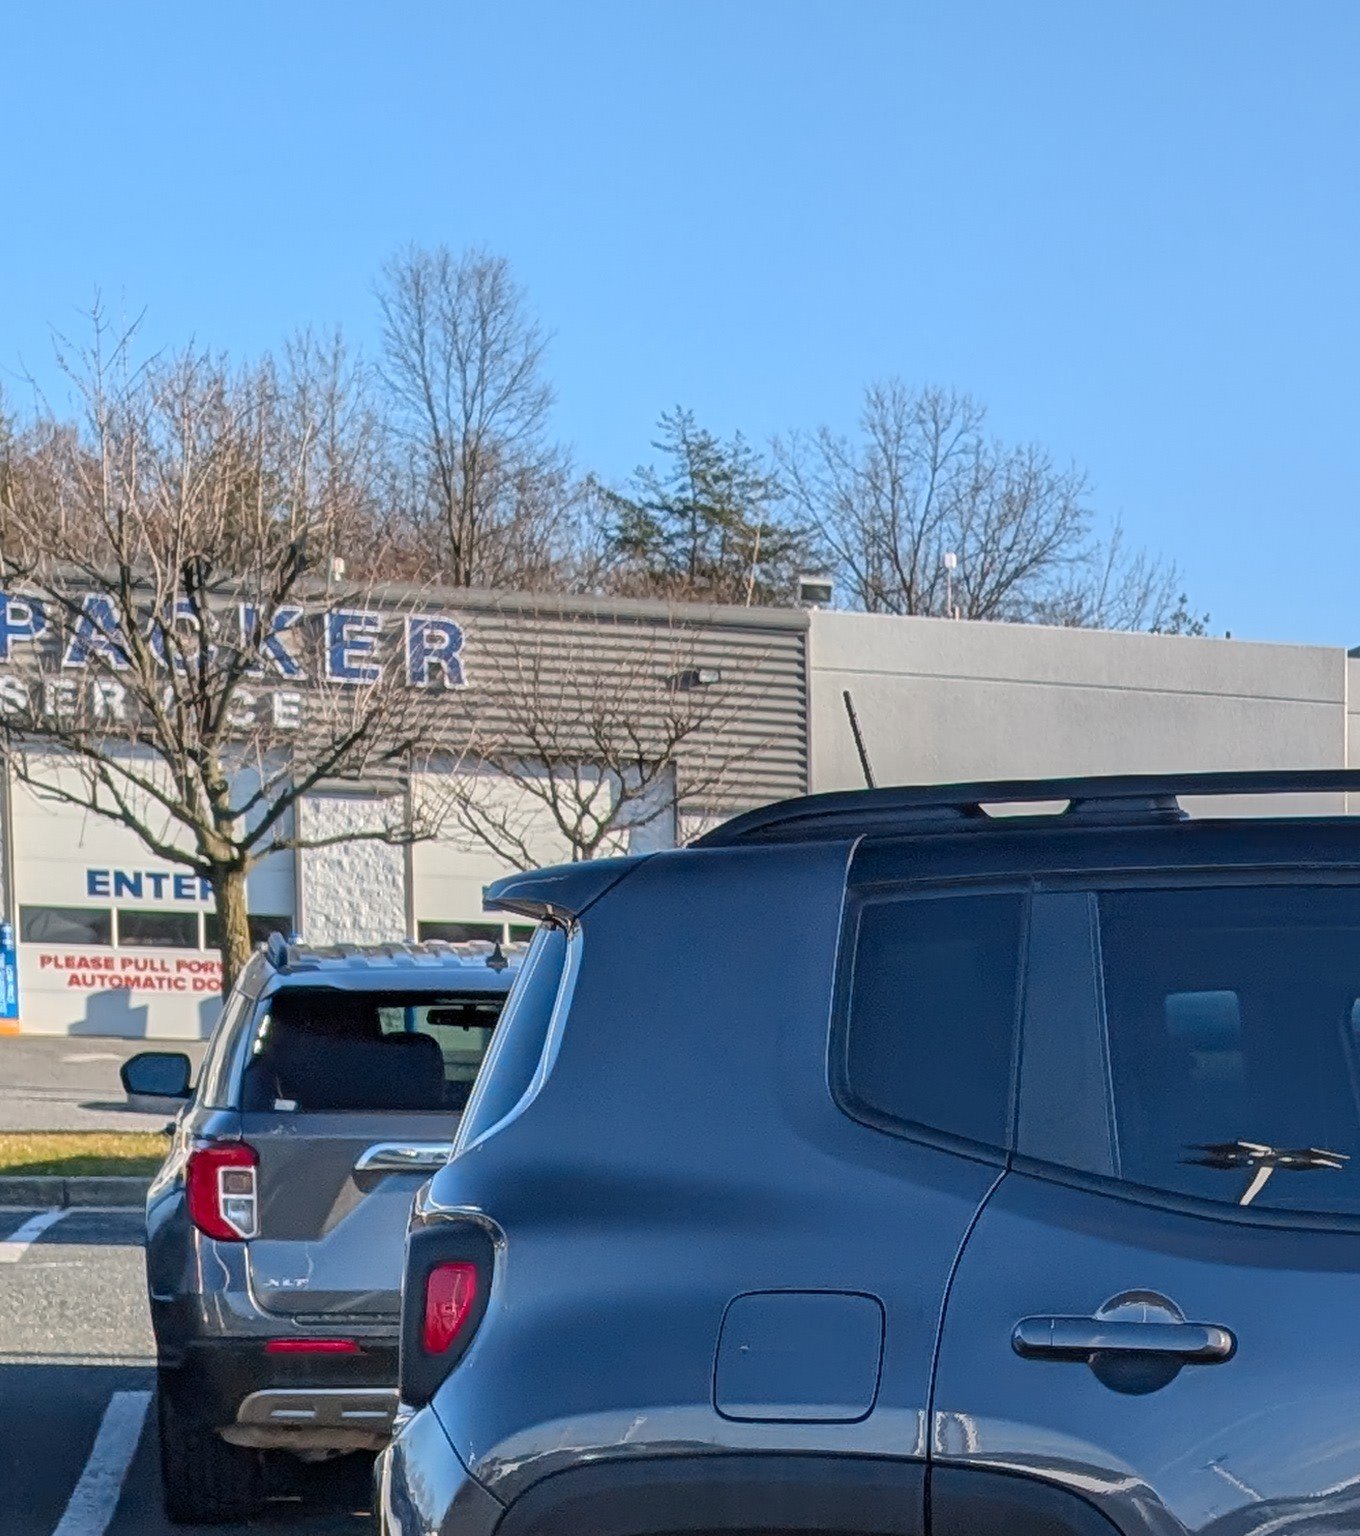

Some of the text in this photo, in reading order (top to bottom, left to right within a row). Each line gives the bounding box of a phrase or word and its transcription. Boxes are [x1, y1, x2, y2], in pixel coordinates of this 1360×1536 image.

[0, 674, 300, 729] SERCE
[39, 953, 225, 975] PLEASE PULL FOR
[67, 973, 225, 993] AUTOMATIC DO
